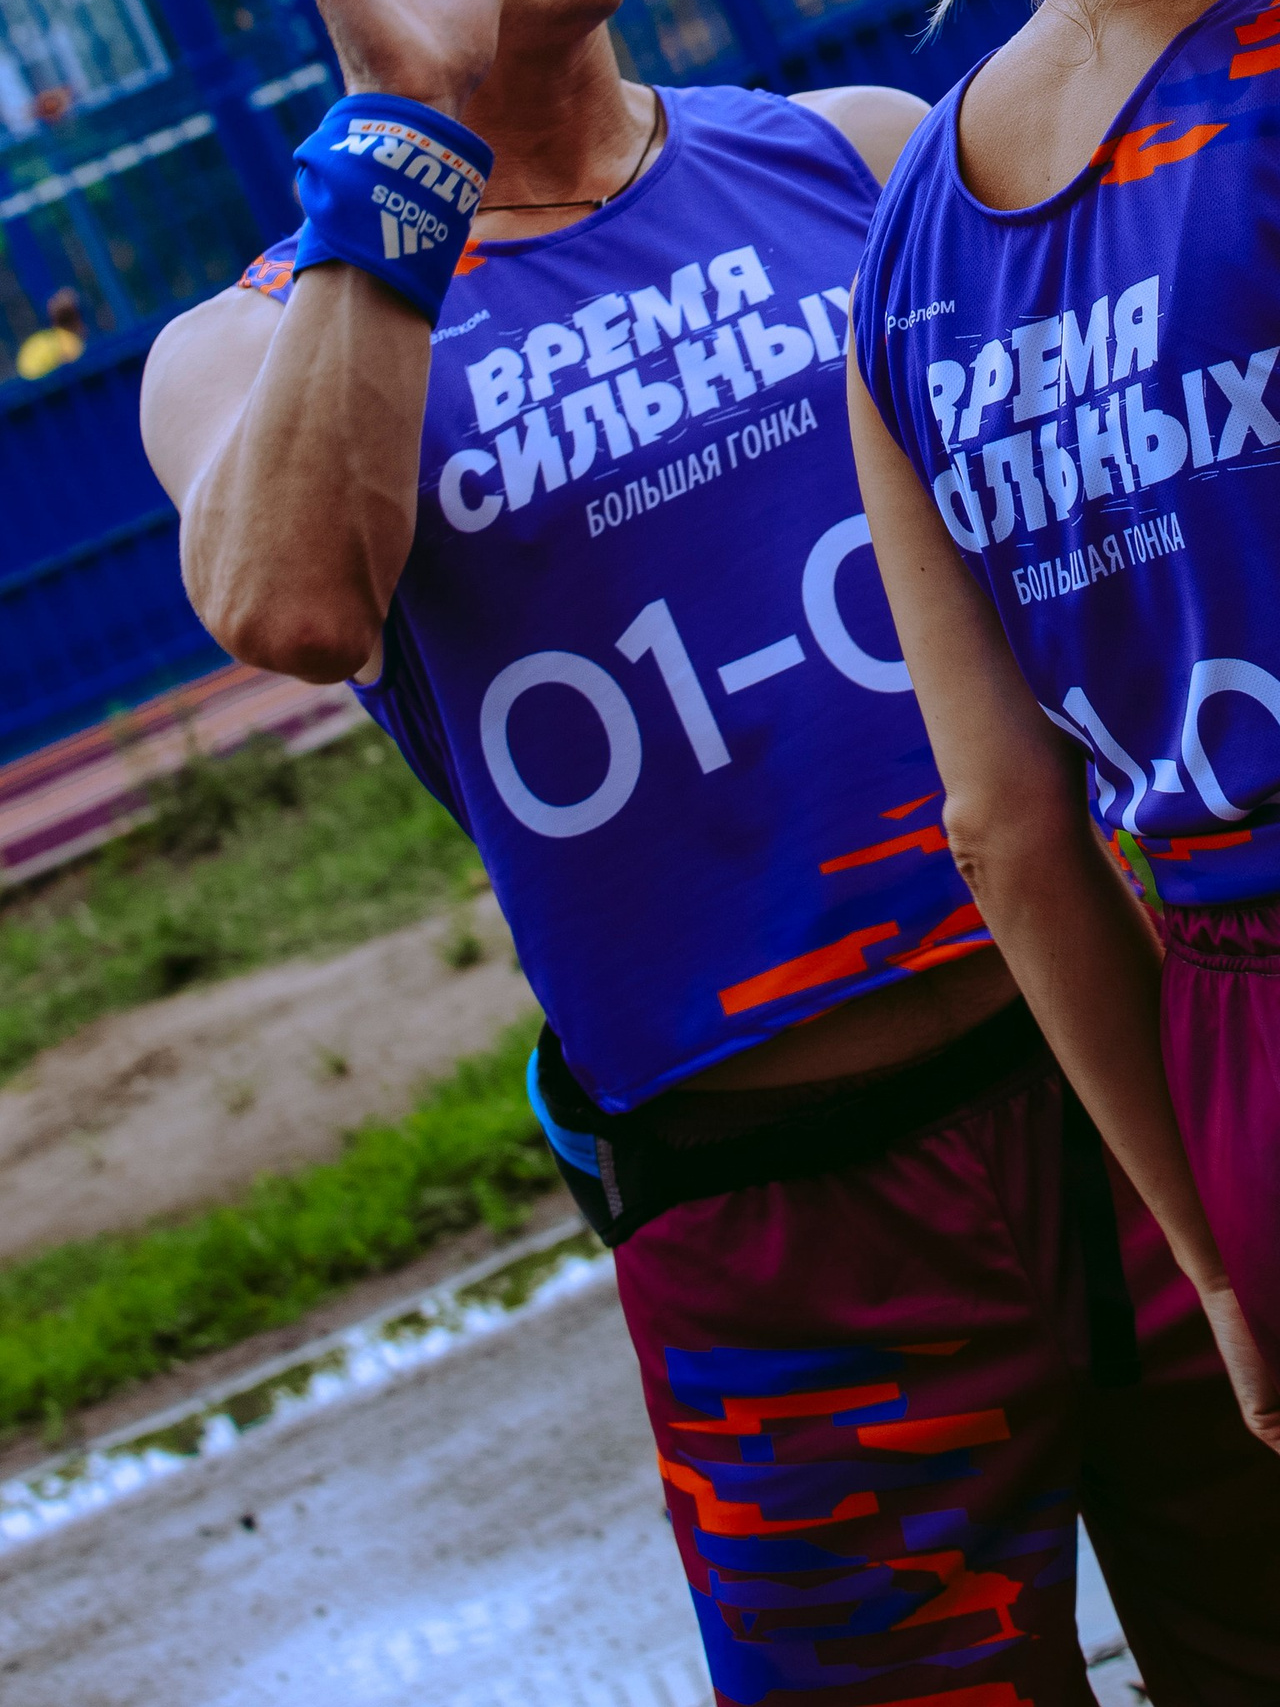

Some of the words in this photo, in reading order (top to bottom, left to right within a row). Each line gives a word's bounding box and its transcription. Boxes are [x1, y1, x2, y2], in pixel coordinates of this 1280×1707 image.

[330, 134, 482, 219] ATURN
[360, 121, 431, 148] GROUP
[371, 184, 449, 243] adidas
[466, 245, 774, 433] ВРЕМЯ
[585, 443, 722, 537] БОЛЬШАЯ
[726, 398, 818, 470] ГОНКА
[1011, 534, 1125, 606] БОЛЬШАЯ
[1123, 512, 1186, 566] ГОНКА
[480, 513, 915, 838] 01-0
